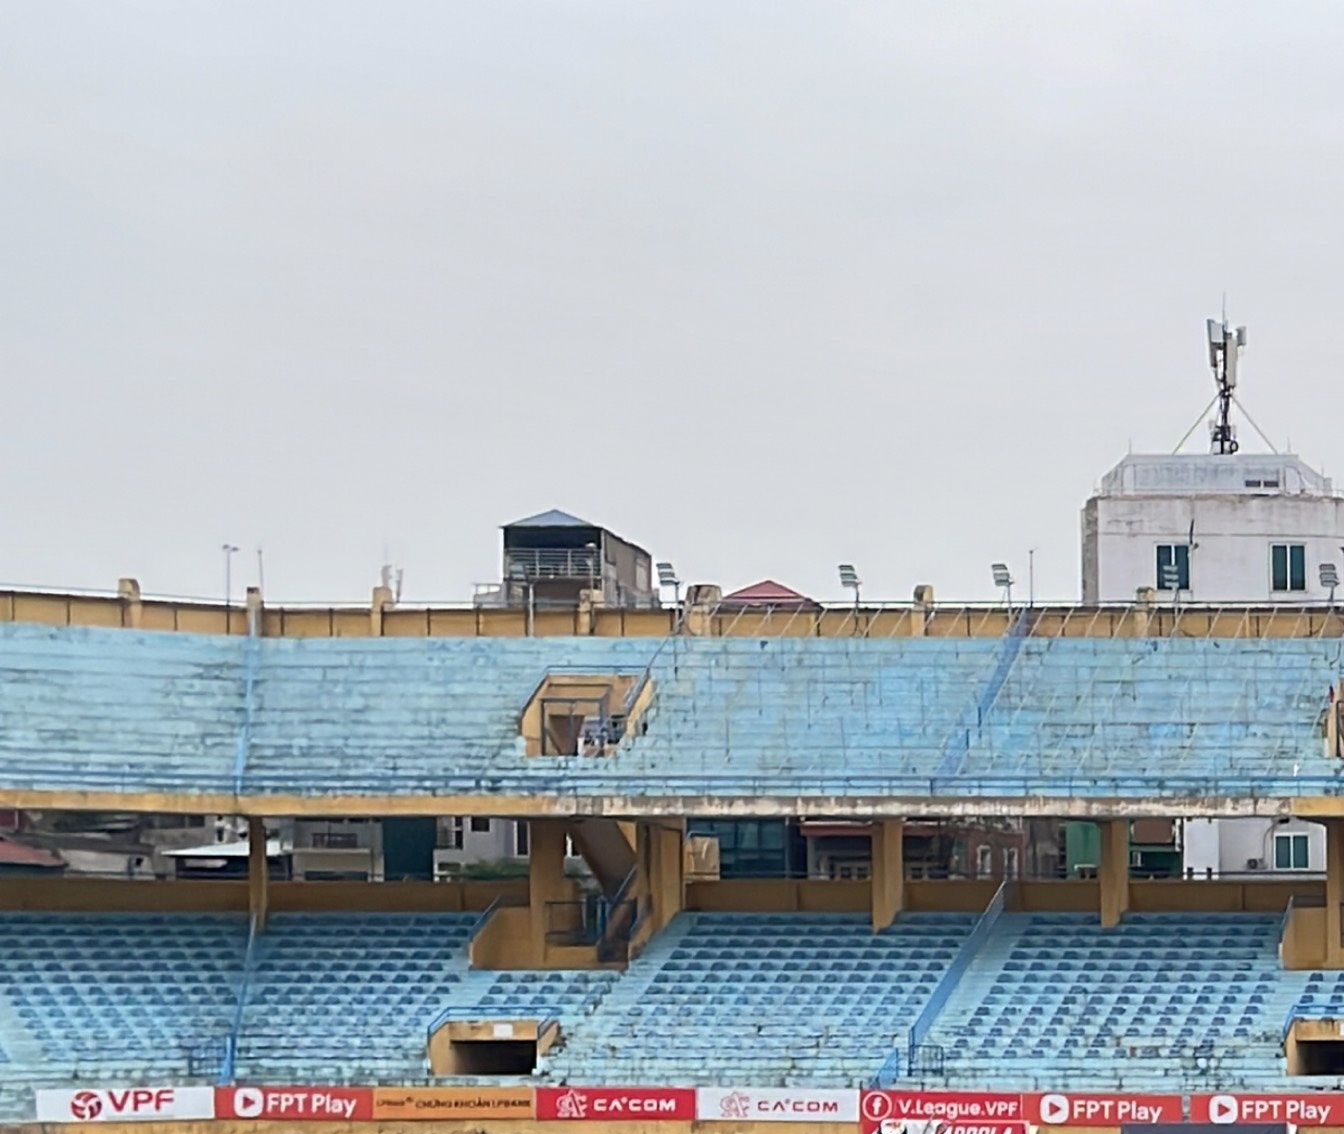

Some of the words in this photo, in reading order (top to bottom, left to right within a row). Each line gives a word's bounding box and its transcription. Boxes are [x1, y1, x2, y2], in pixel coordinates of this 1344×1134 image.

[108, 1089, 174, 1111] VPF
[267, 1093, 307, 1112] FPT
[311, 1093, 357, 1117] Play
[897, 1098, 1018, 1120] V.League.VPF
[1073, 1100, 1114, 1118] FPT
[1118, 1100, 1162, 1123] Play
[1242, 1101, 1283, 1118] FPT
[1286, 1101, 1331, 1124] Play
